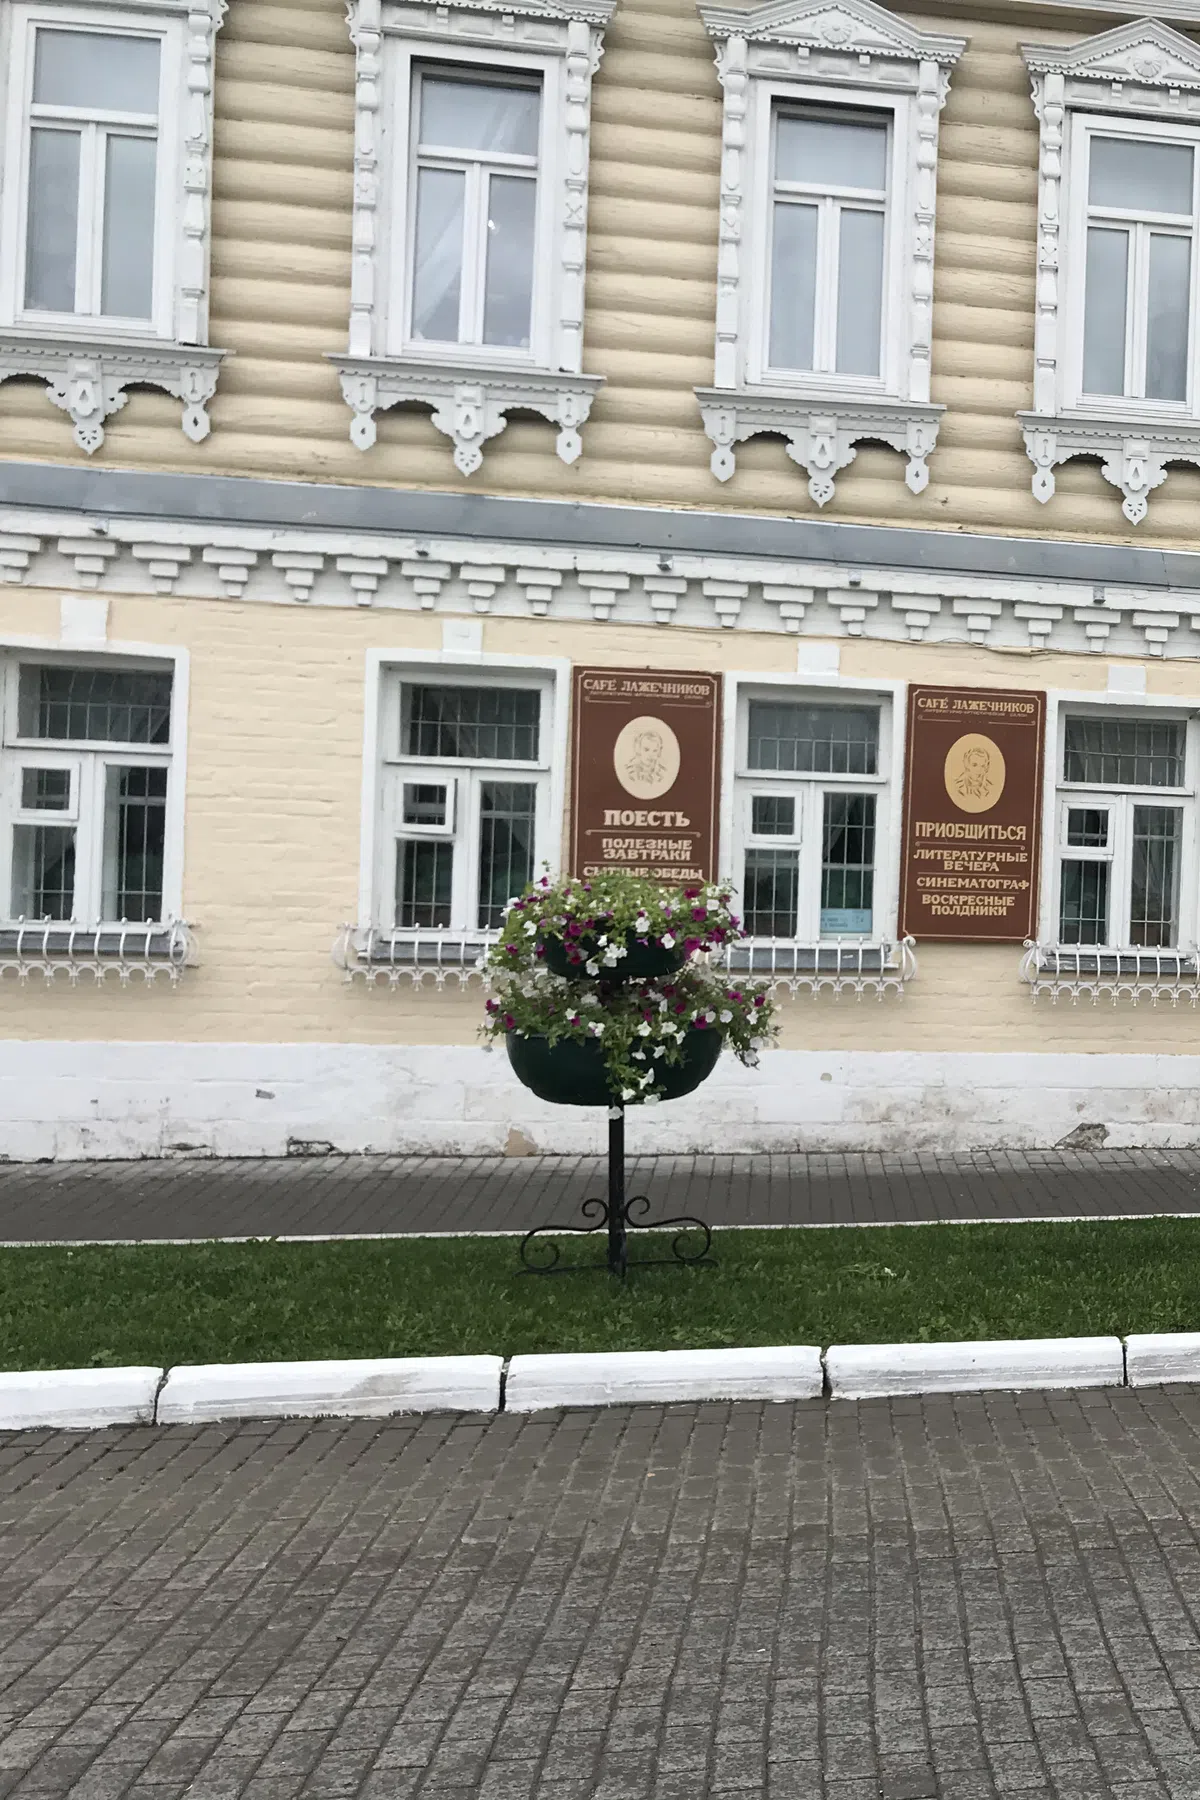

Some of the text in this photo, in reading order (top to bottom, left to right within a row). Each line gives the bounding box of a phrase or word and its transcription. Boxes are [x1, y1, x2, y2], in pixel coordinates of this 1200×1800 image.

[621, 681, 710, 695] ЛАЖЕЧНИКОВ
[952, 700, 1034, 714] ЛАЖЕЧНИКОВ
[603, 809, 691, 827] ПОЕСТЬ
[915, 822, 1026, 840] ПРИОБЩИТЬСЯ
[602, 838, 692, 850] ПОЛЕЗНЫЕ
[603, 849, 691, 861] ЗАВТРАКИ
[913, 849, 1028, 862] ЛИТЕРАТУРНЫЕ
[943, 861, 1000, 871] ВЕЧЕРА
[651, 868, 703, 880] ОБЕДЫ
[916, 877, 1030, 890] СИНЕМАТОГРАФ
[922, 894, 1015, 906] ВОСКРЕСНЫЕ
[931, 905, 1007, 916] ПОЛДНИКИ
